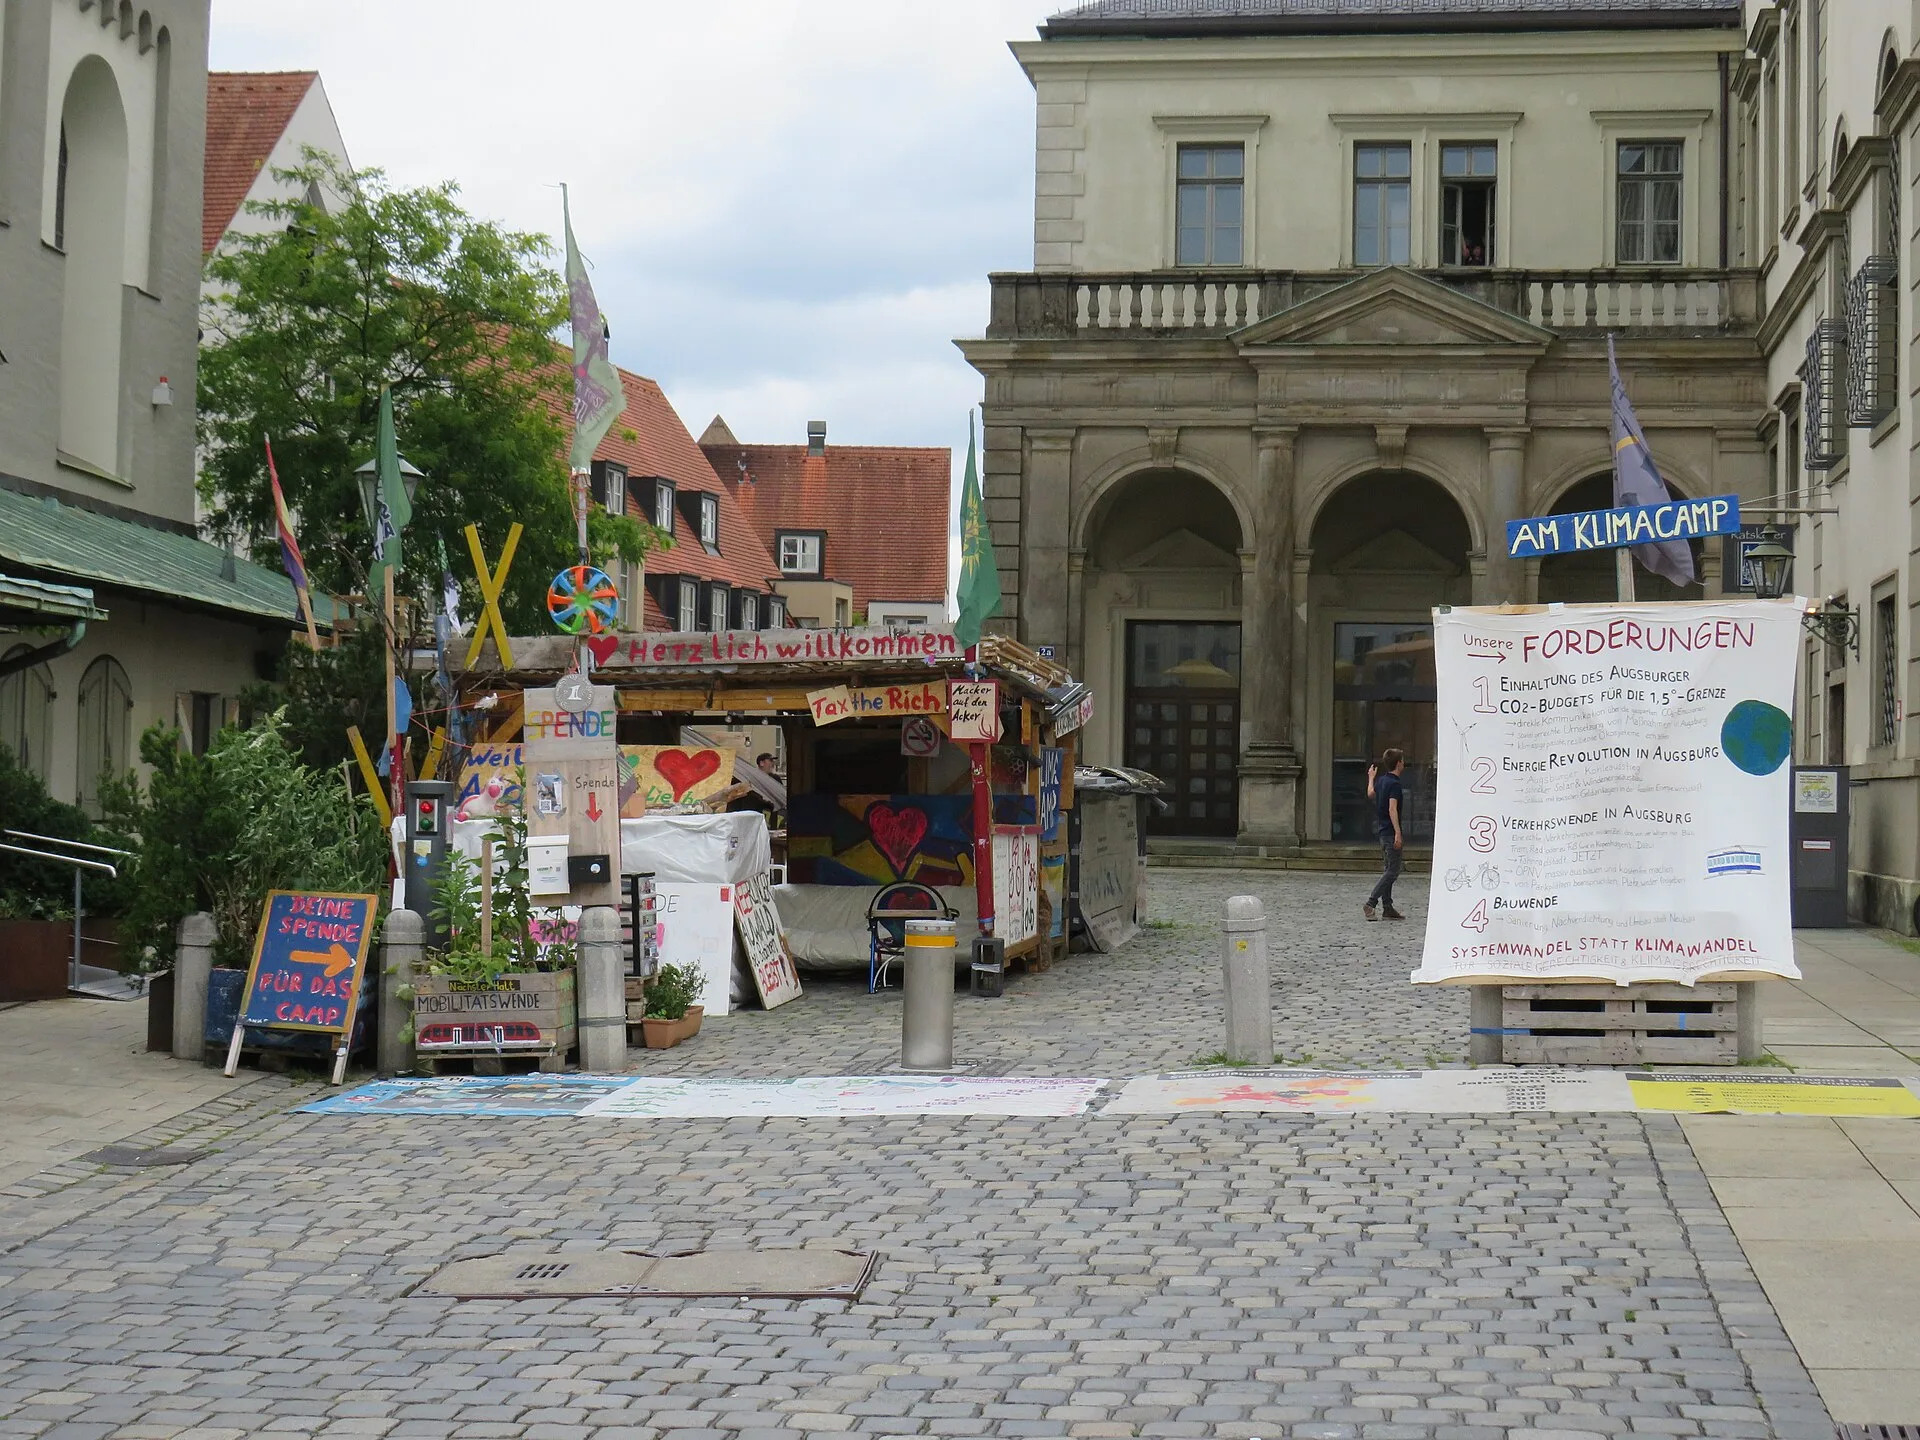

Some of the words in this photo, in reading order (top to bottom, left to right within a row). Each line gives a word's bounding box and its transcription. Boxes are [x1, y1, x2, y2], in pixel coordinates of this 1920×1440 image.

[1510, 520, 1559, 554] AM
[1574, 499, 1729, 549] KLIMACAMP
[628, 633, 768, 663] Herzlich
[775, 631, 955, 660] willkommen
[1463, 633, 1513, 650] Unsere
[1523, 619, 1754, 663] FORDERUNGEN
[812, 696, 849, 719] Tax
[851, 692, 883, 712] the
[885, 684, 941, 713] Rich
[952, 684, 992, 695] Macker
[952, 697, 969, 708] auf
[971, 697, 988, 707] den
[1472, 675, 1498, 714] 1
[1500, 674, 1576, 692] EINHALTUNG
[1582, 670, 1603, 684] DES
[1609, 665, 1690, 682] AUGSBURGER
[1500, 693, 1593, 714] CO2-BUDGETS
[1601, 687, 1622, 701] FÜR
[1627, 689, 1645, 701] DIE
[527, 710, 615, 740] SPENDE
[952, 710, 982, 722] Acker
[575, 776, 615, 790] Spende
[1470, 756, 1498, 795] 2
[1636, 748, 1649, 759] IN
[1652, 745, 1719, 762] AUGSBURG
[1468, 815, 1498, 853] 3
[1501, 811, 1598, 831] VERKEHRSWENDE
[1604, 808, 1617, 818] IN
[1623, 805, 1692, 824] AUGSBURG
[289, 895, 355, 919] DEINE
[1460, 898, 1490, 934] 4
[1493, 895, 1559, 909] BAUWENDE
[278, 916, 360, 943] SPENDE
[1451, 940, 1573, 959] SYSTEMWANDEL
[1579, 937, 1629, 951] STATT
[1635, 938, 1758, 957] KLIMAWANDEL
[259, 969, 304, 993] FÜR
[310, 975, 354, 1000] DAS
[494, 980, 516, 991] Halt
[275, 1001, 340, 1025] CAMP
